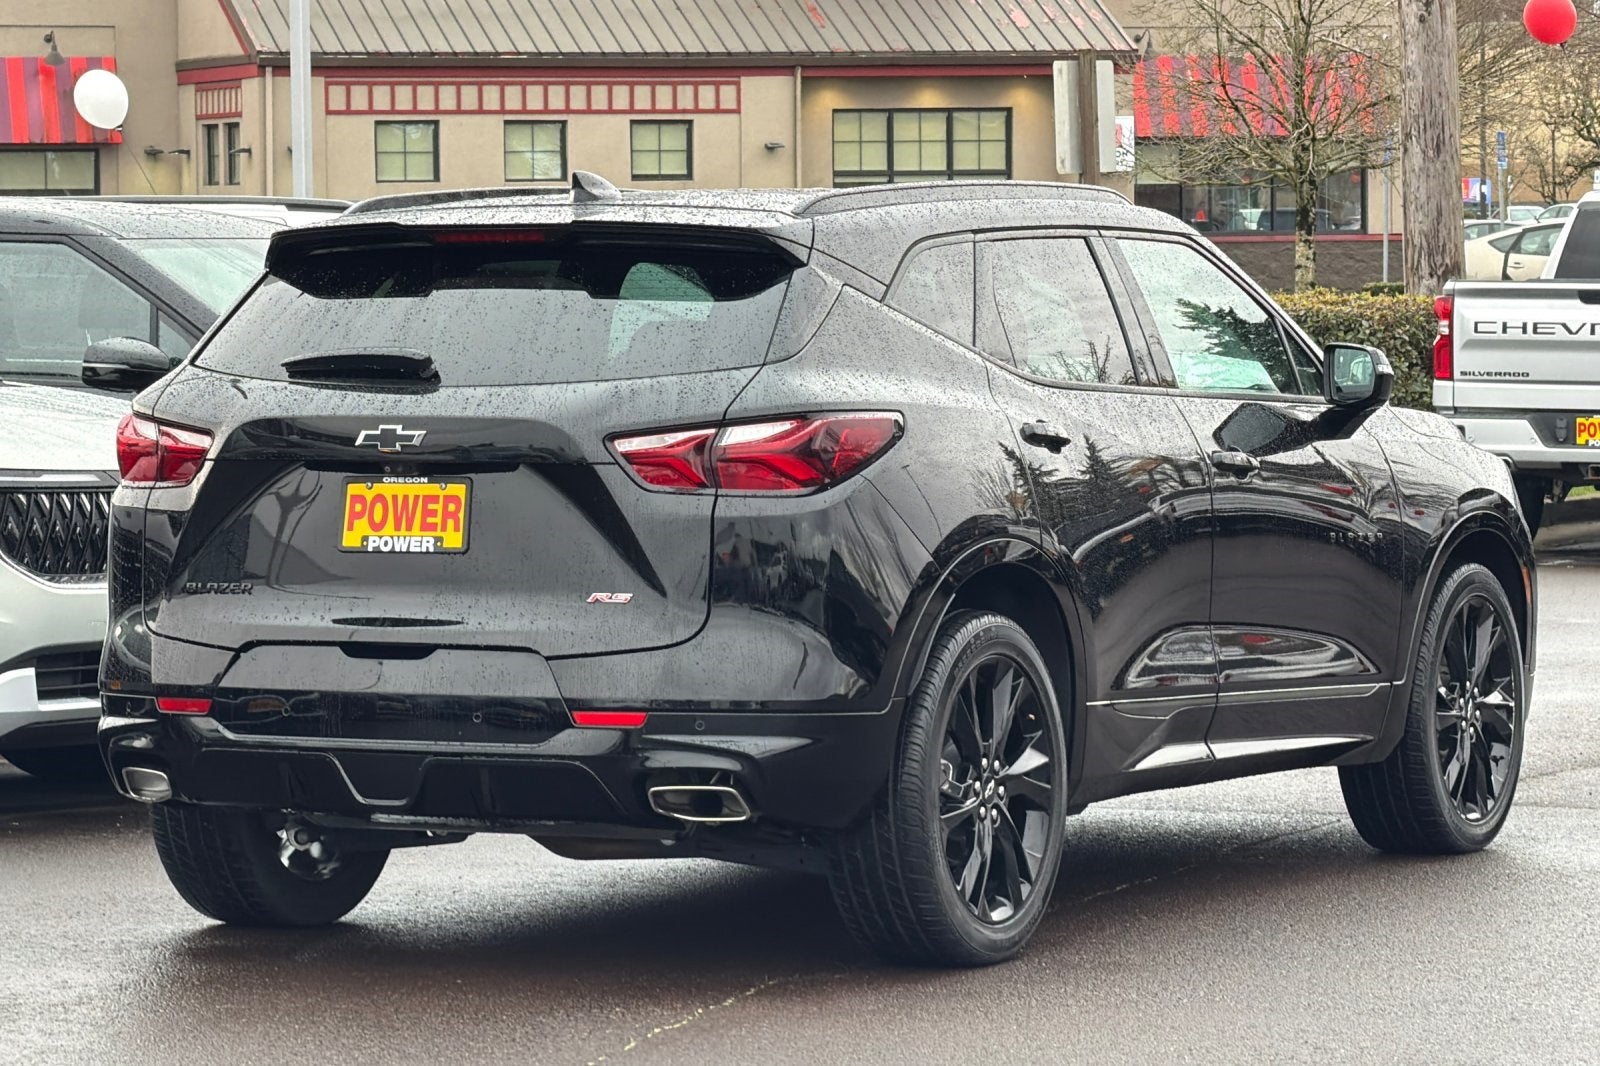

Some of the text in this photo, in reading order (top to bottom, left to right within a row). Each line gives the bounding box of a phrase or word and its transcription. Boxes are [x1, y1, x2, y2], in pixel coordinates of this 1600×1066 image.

[1460, 370, 1530, 378] SILVERADO
[1578, 421, 1600, 438] PO
[346, 493, 463, 533] POWER
[367, 536, 435, 552] POWER
[184, 582, 254, 595] BLAZER
[586, 592, 634, 604] RS
